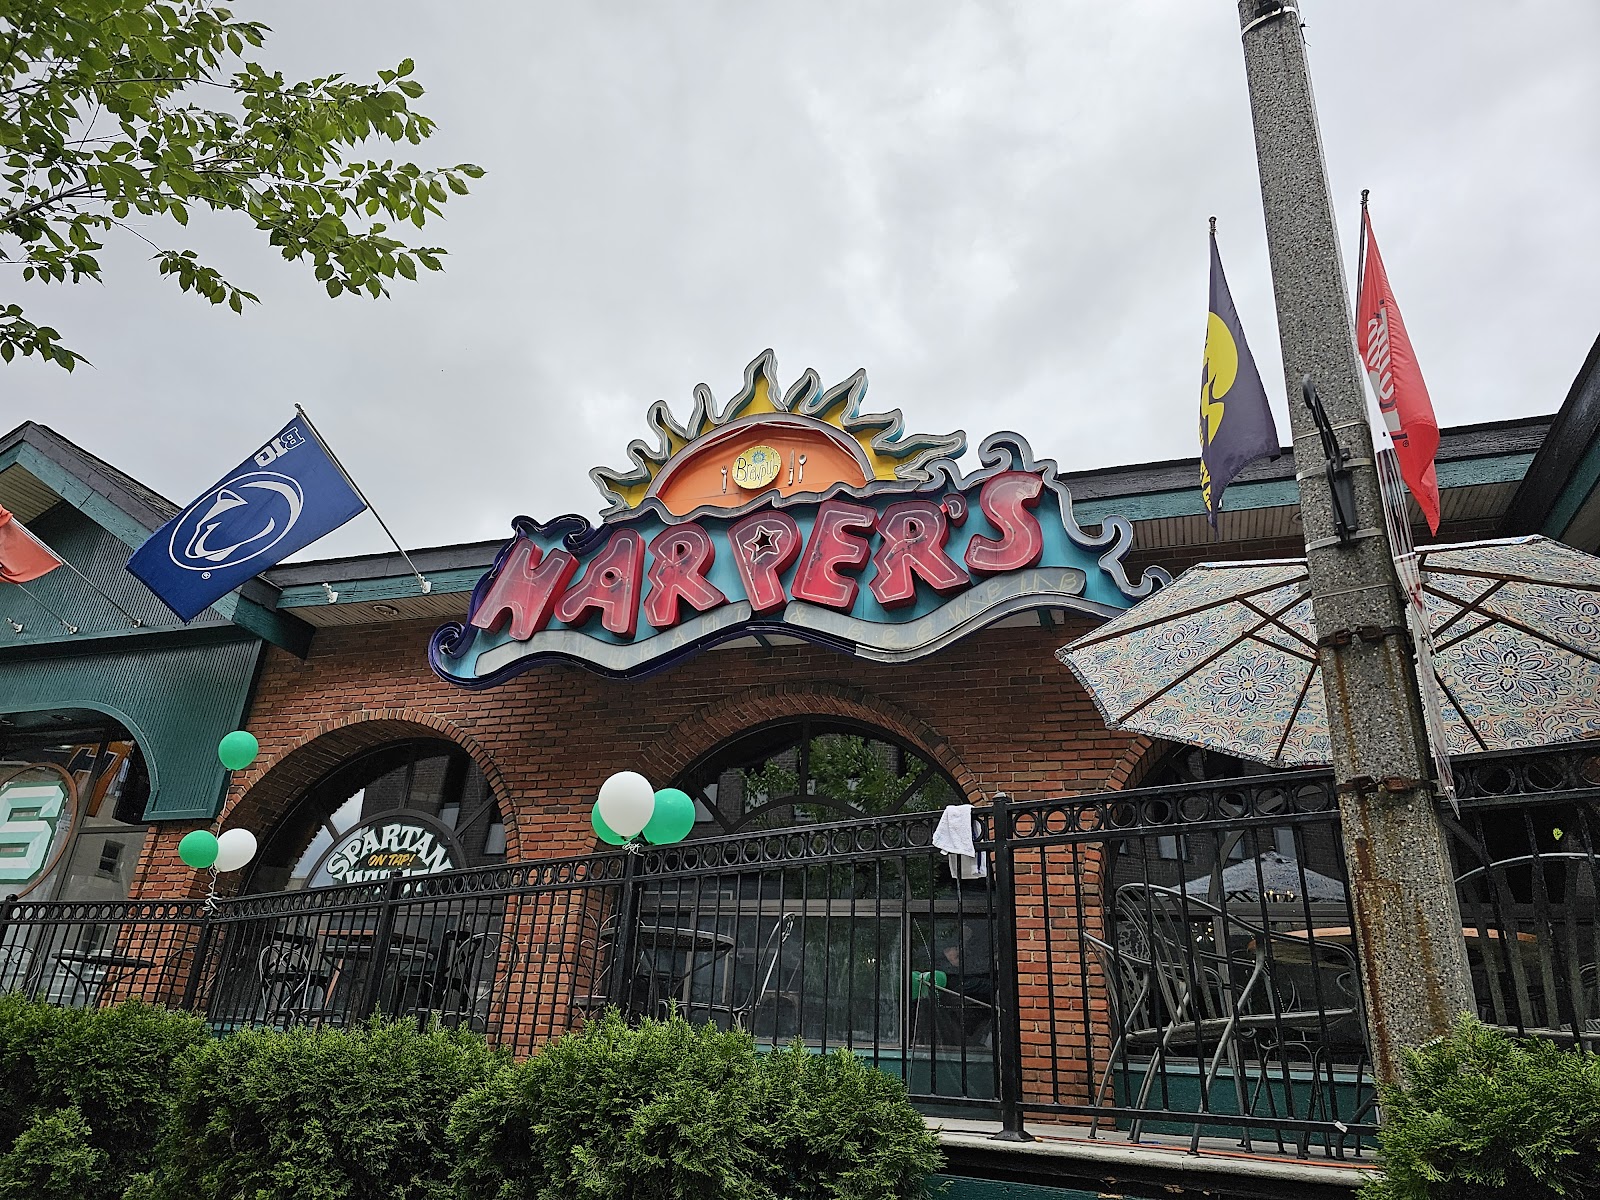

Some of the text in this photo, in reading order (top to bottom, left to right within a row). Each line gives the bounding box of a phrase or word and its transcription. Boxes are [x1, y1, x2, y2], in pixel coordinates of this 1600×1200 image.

[471, 471, 1046, 641] HARPER'S
[327, 824, 453, 880] SPARTAN
[367, 853, 417, 867] ON TAP!
